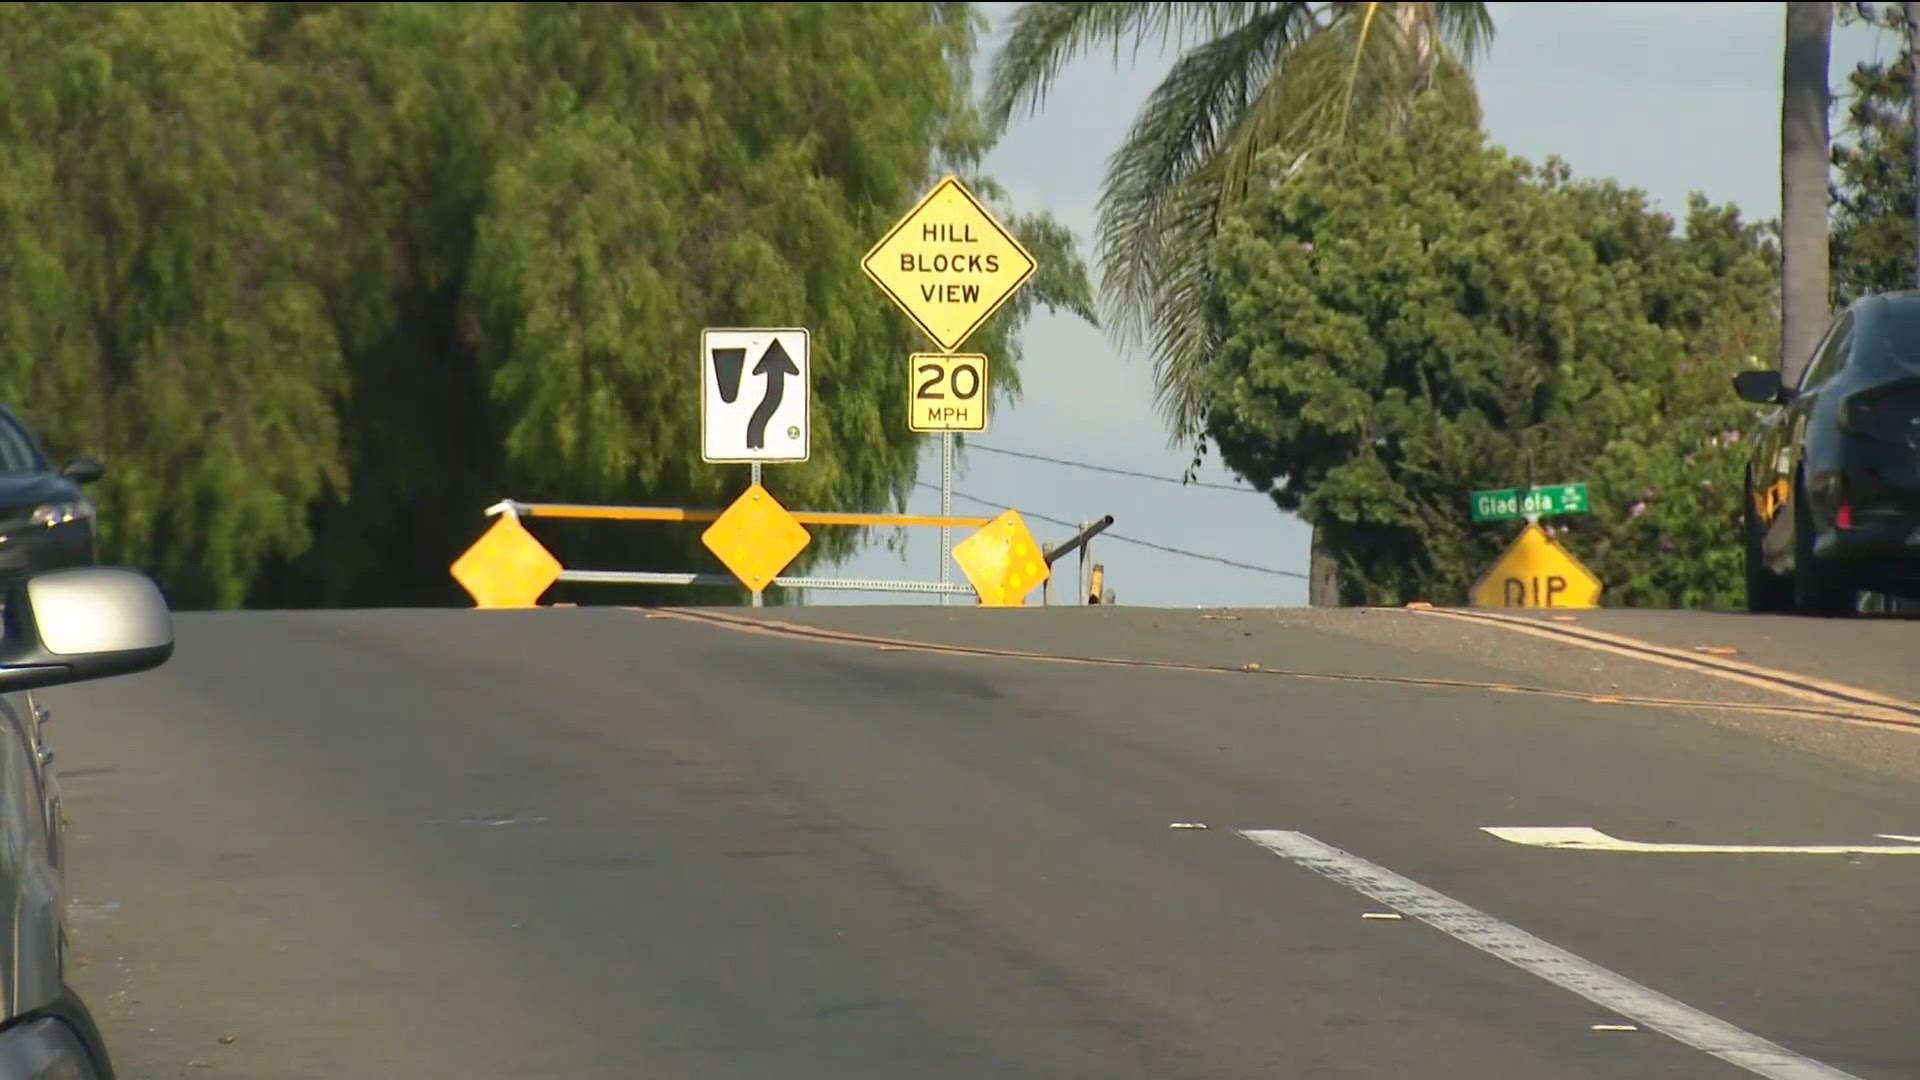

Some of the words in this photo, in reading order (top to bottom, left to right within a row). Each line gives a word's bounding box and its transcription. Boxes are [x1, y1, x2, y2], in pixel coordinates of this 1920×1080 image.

[922, 223, 978, 243] HILL
[900, 253, 1000, 273] BLOCKS
[920, 284, 980, 304] VIEW
[917, 363, 980, 400] 20
[928, 407, 968, 422] MPH
[1479, 493, 1553, 516] Gladola
[1504, 576, 1567, 608] DIP
